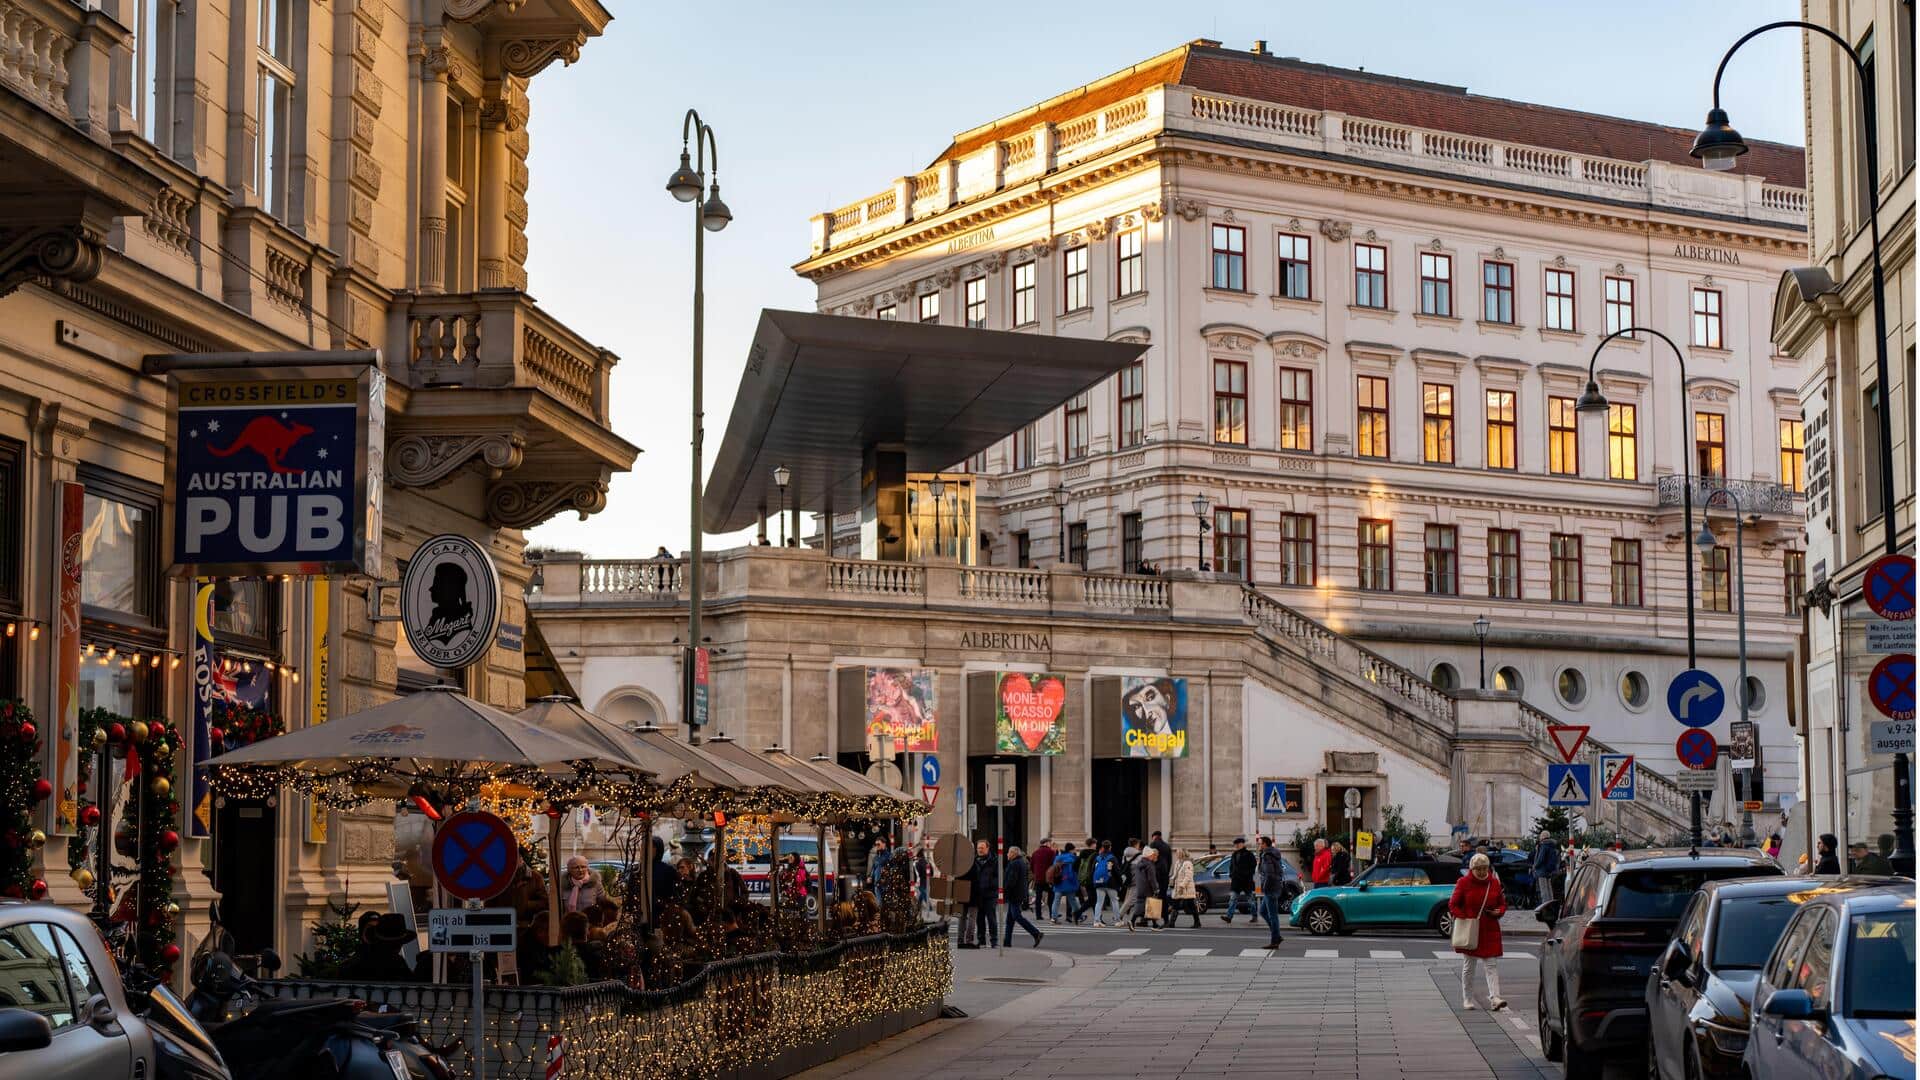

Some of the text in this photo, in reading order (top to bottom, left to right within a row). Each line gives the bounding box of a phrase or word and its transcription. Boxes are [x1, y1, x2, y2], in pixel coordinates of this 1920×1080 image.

[947, 227, 995, 254] ALBERTINA
[1674, 244, 1740, 265] ALBERTINA
[189, 383, 347, 401] CROSSFIELD'S
[187, 469, 343, 491] AUSTRALIAN
[185, 494, 345, 553] PUB
[432, 544, 468, 557] CAFE
[425, 613, 471, 637] Mozart
[415, 629, 429, 651] BEI
[429, 647, 450, 659] DER
[453, 630, 479, 656] OPER
[960, 631, 1051, 651] ALBERTINA
[1002, 691, 1045, 705] MONET
[1002, 705, 1053, 718] PICASSO
[1010, 719, 1056, 732] JIM DINE
[1125, 728, 1185, 752] Chagall
[1618, 776, 1630, 786] 20
[451, 915, 463, 926] ab
[474, 935, 489, 946] bis
